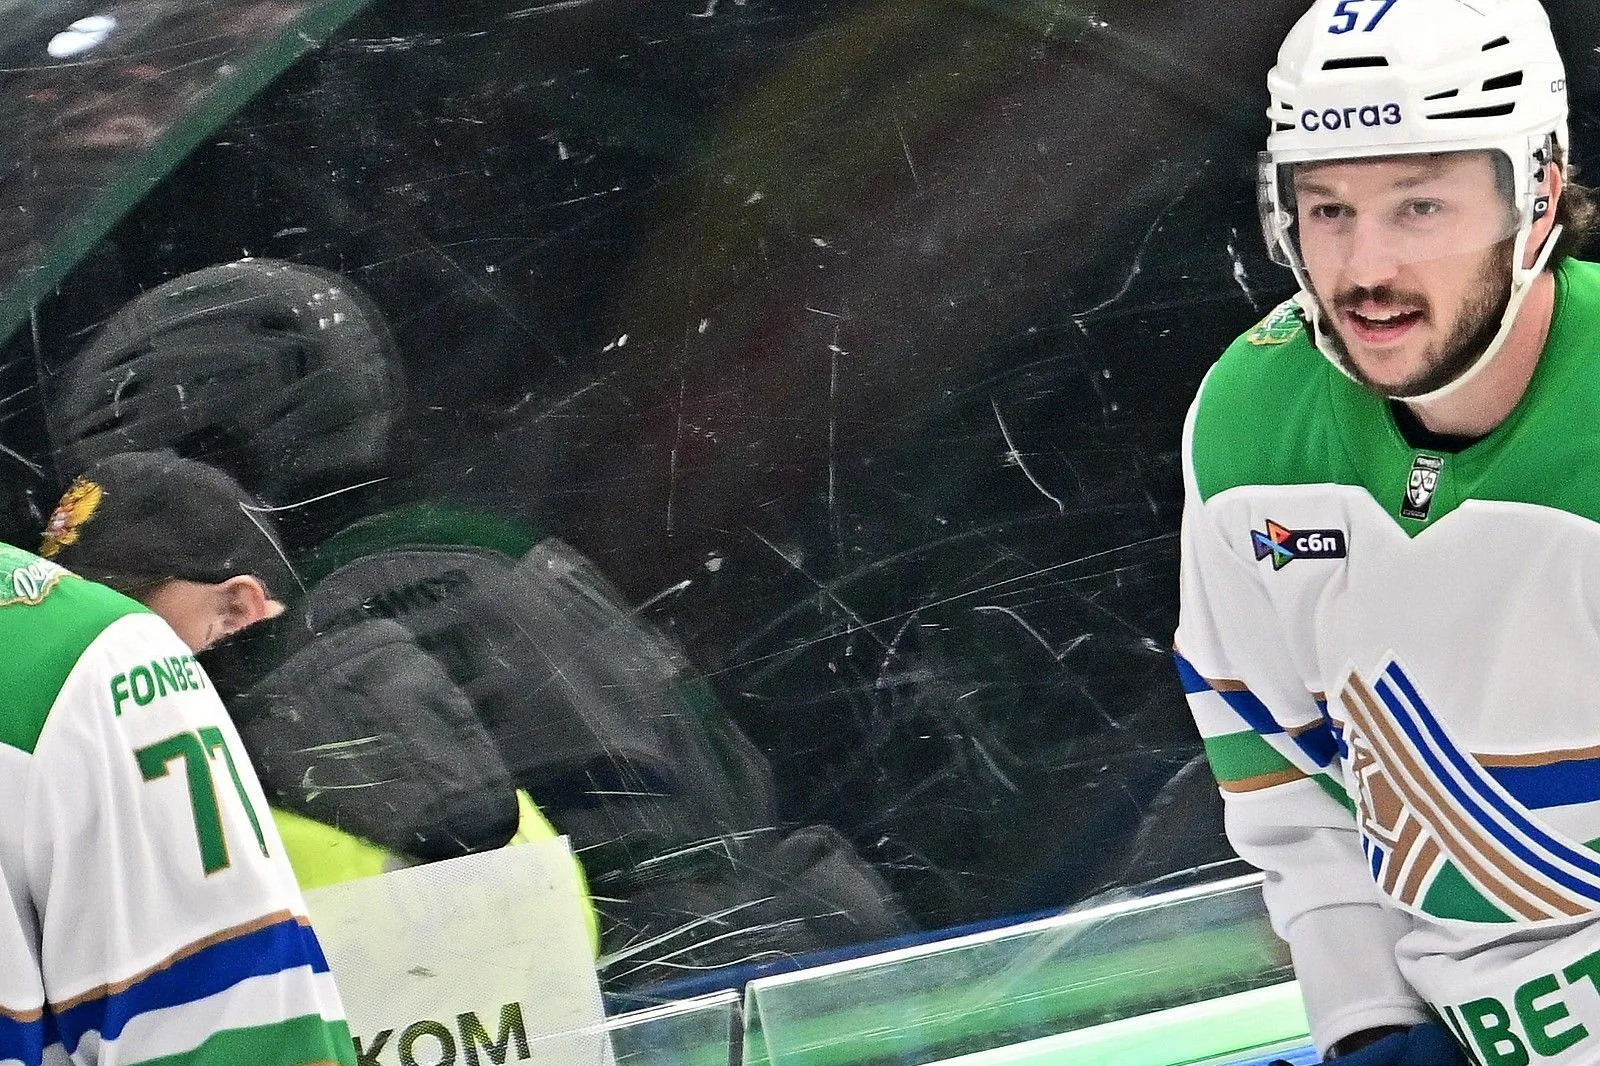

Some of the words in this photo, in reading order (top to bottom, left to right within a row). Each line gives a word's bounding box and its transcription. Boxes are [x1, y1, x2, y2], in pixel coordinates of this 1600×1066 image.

[1301, 103, 1402, 131] согаз
[1296, 533, 1337, 552] сбп
[133, 726, 270, 878] 77
